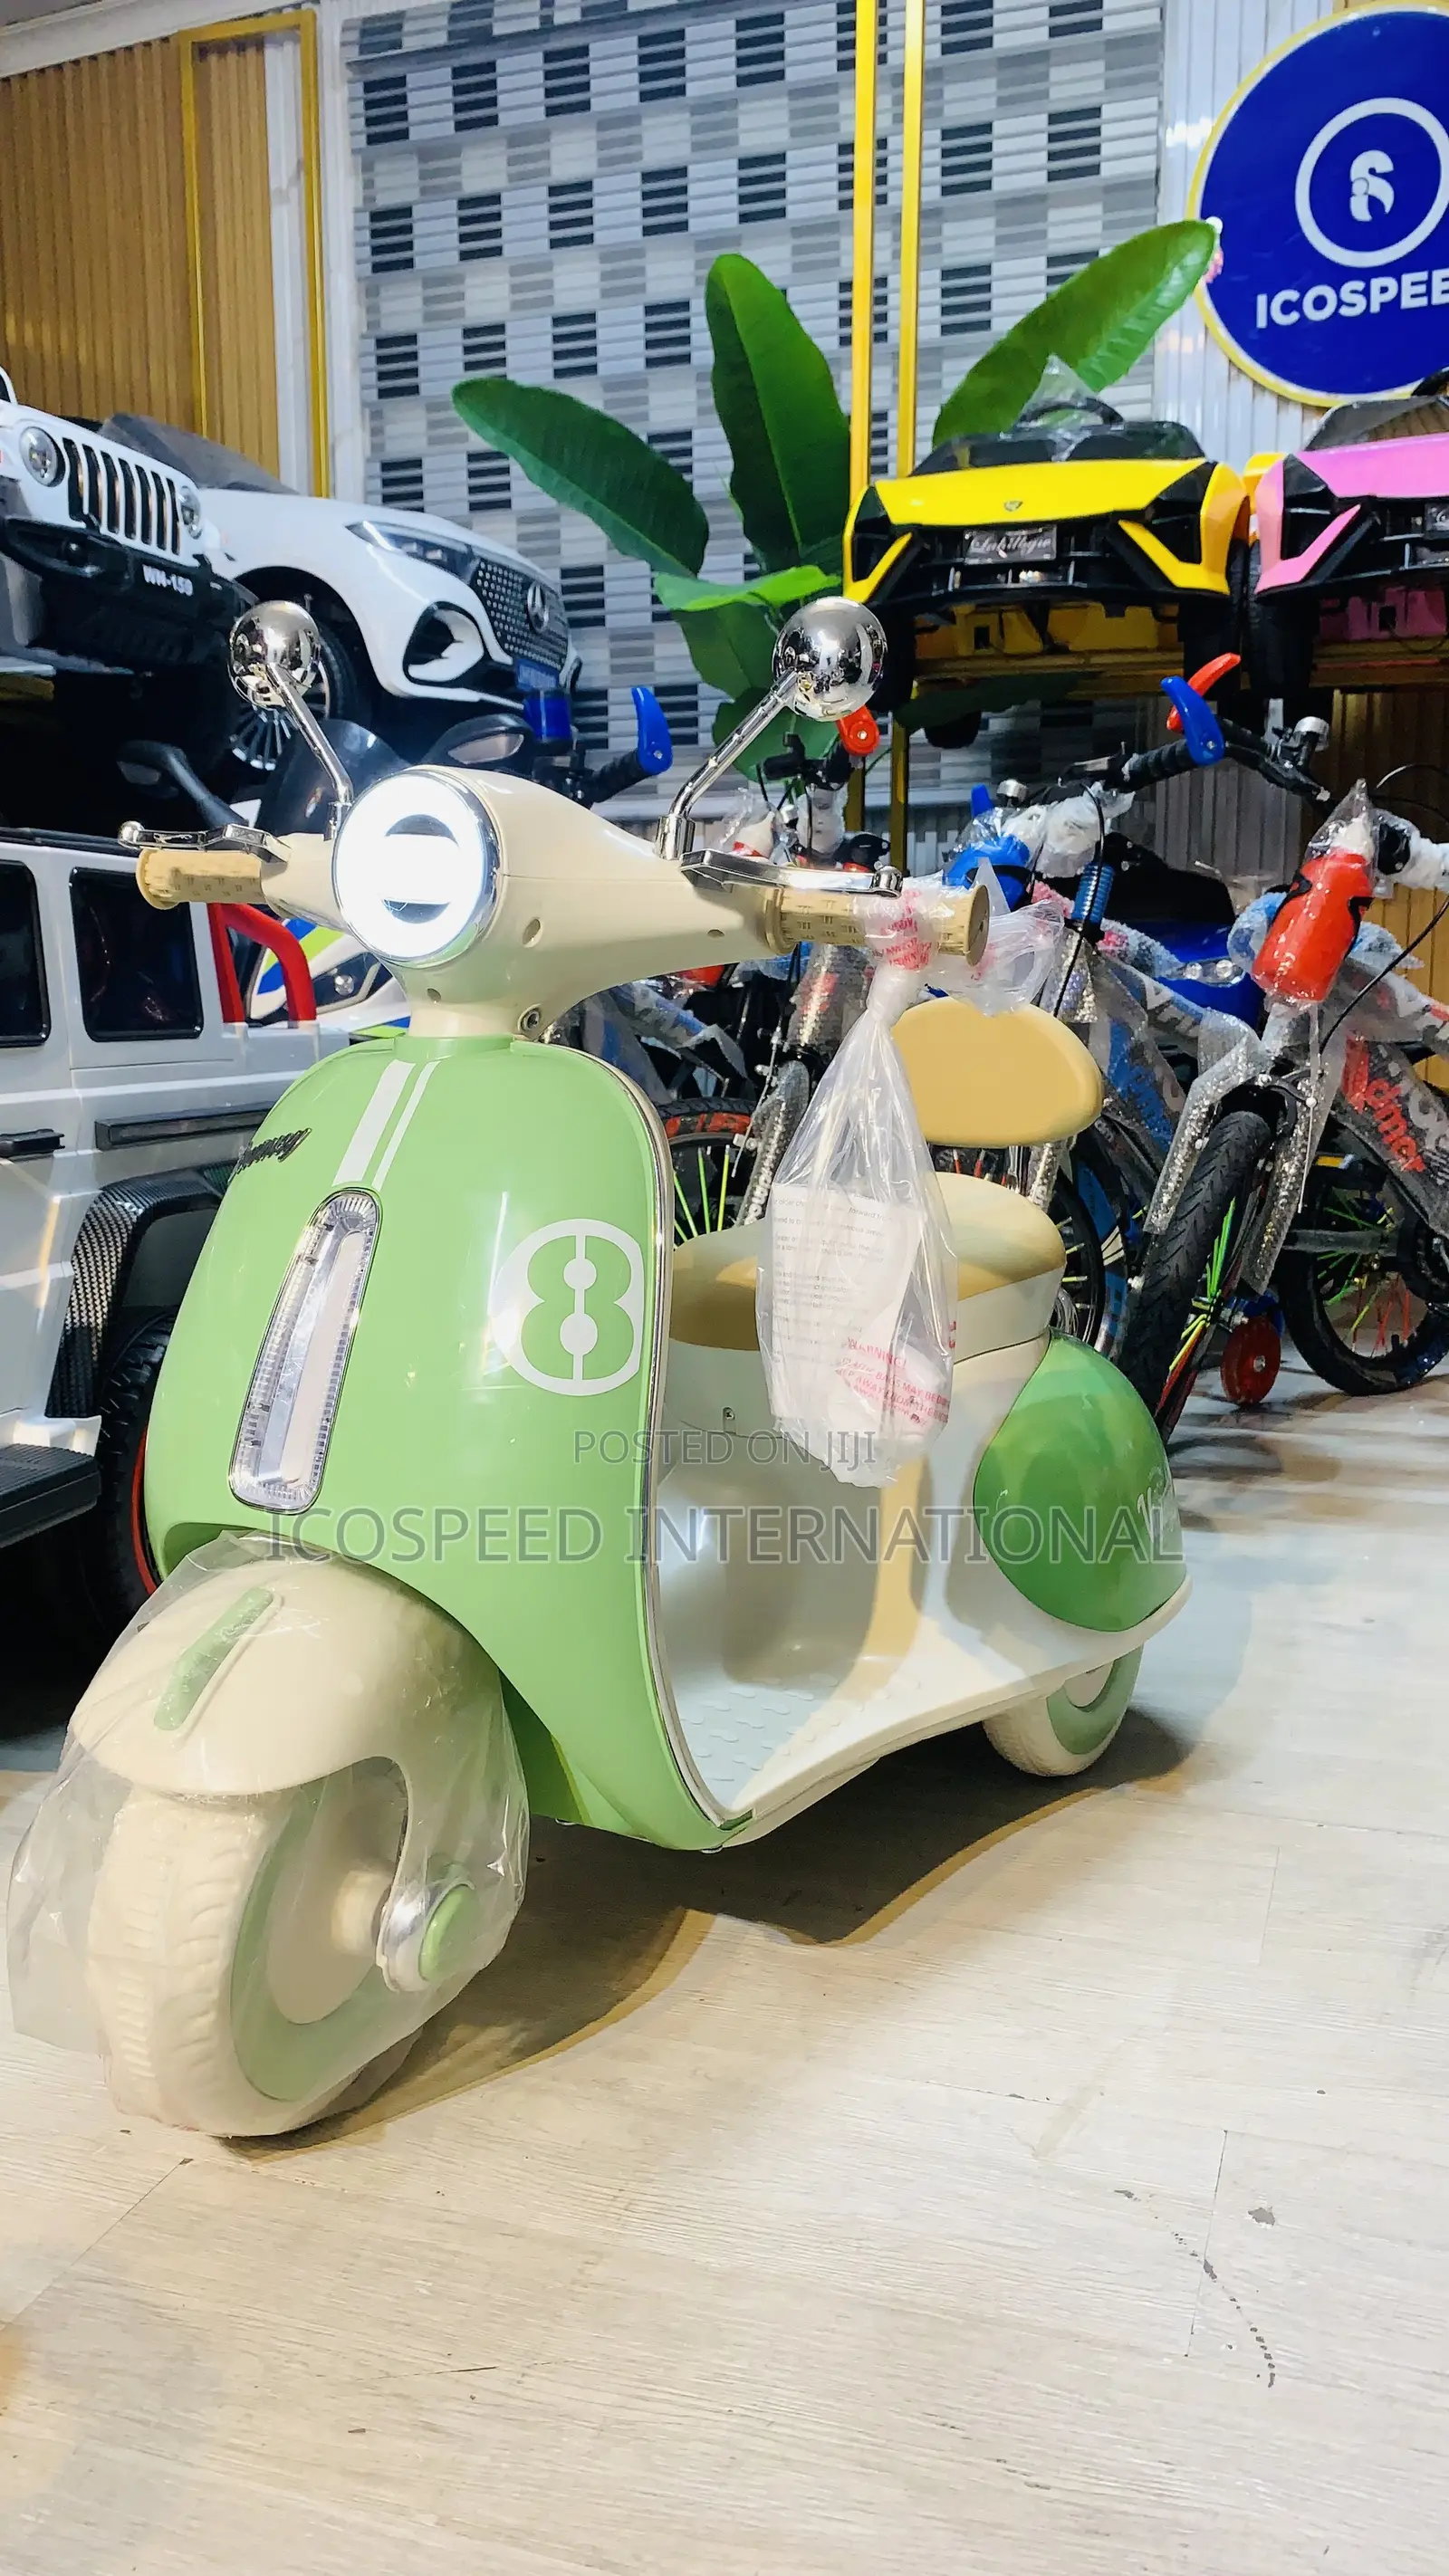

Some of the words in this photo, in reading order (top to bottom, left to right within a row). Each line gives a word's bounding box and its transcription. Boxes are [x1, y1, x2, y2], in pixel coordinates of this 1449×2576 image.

[849, 1206, 876, 1219] forward
[848, 1338, 907, 1369] WARNING!
[855, 1374, 883, 1395] AWAY
[902, 1381, 923, 1395] MAY
